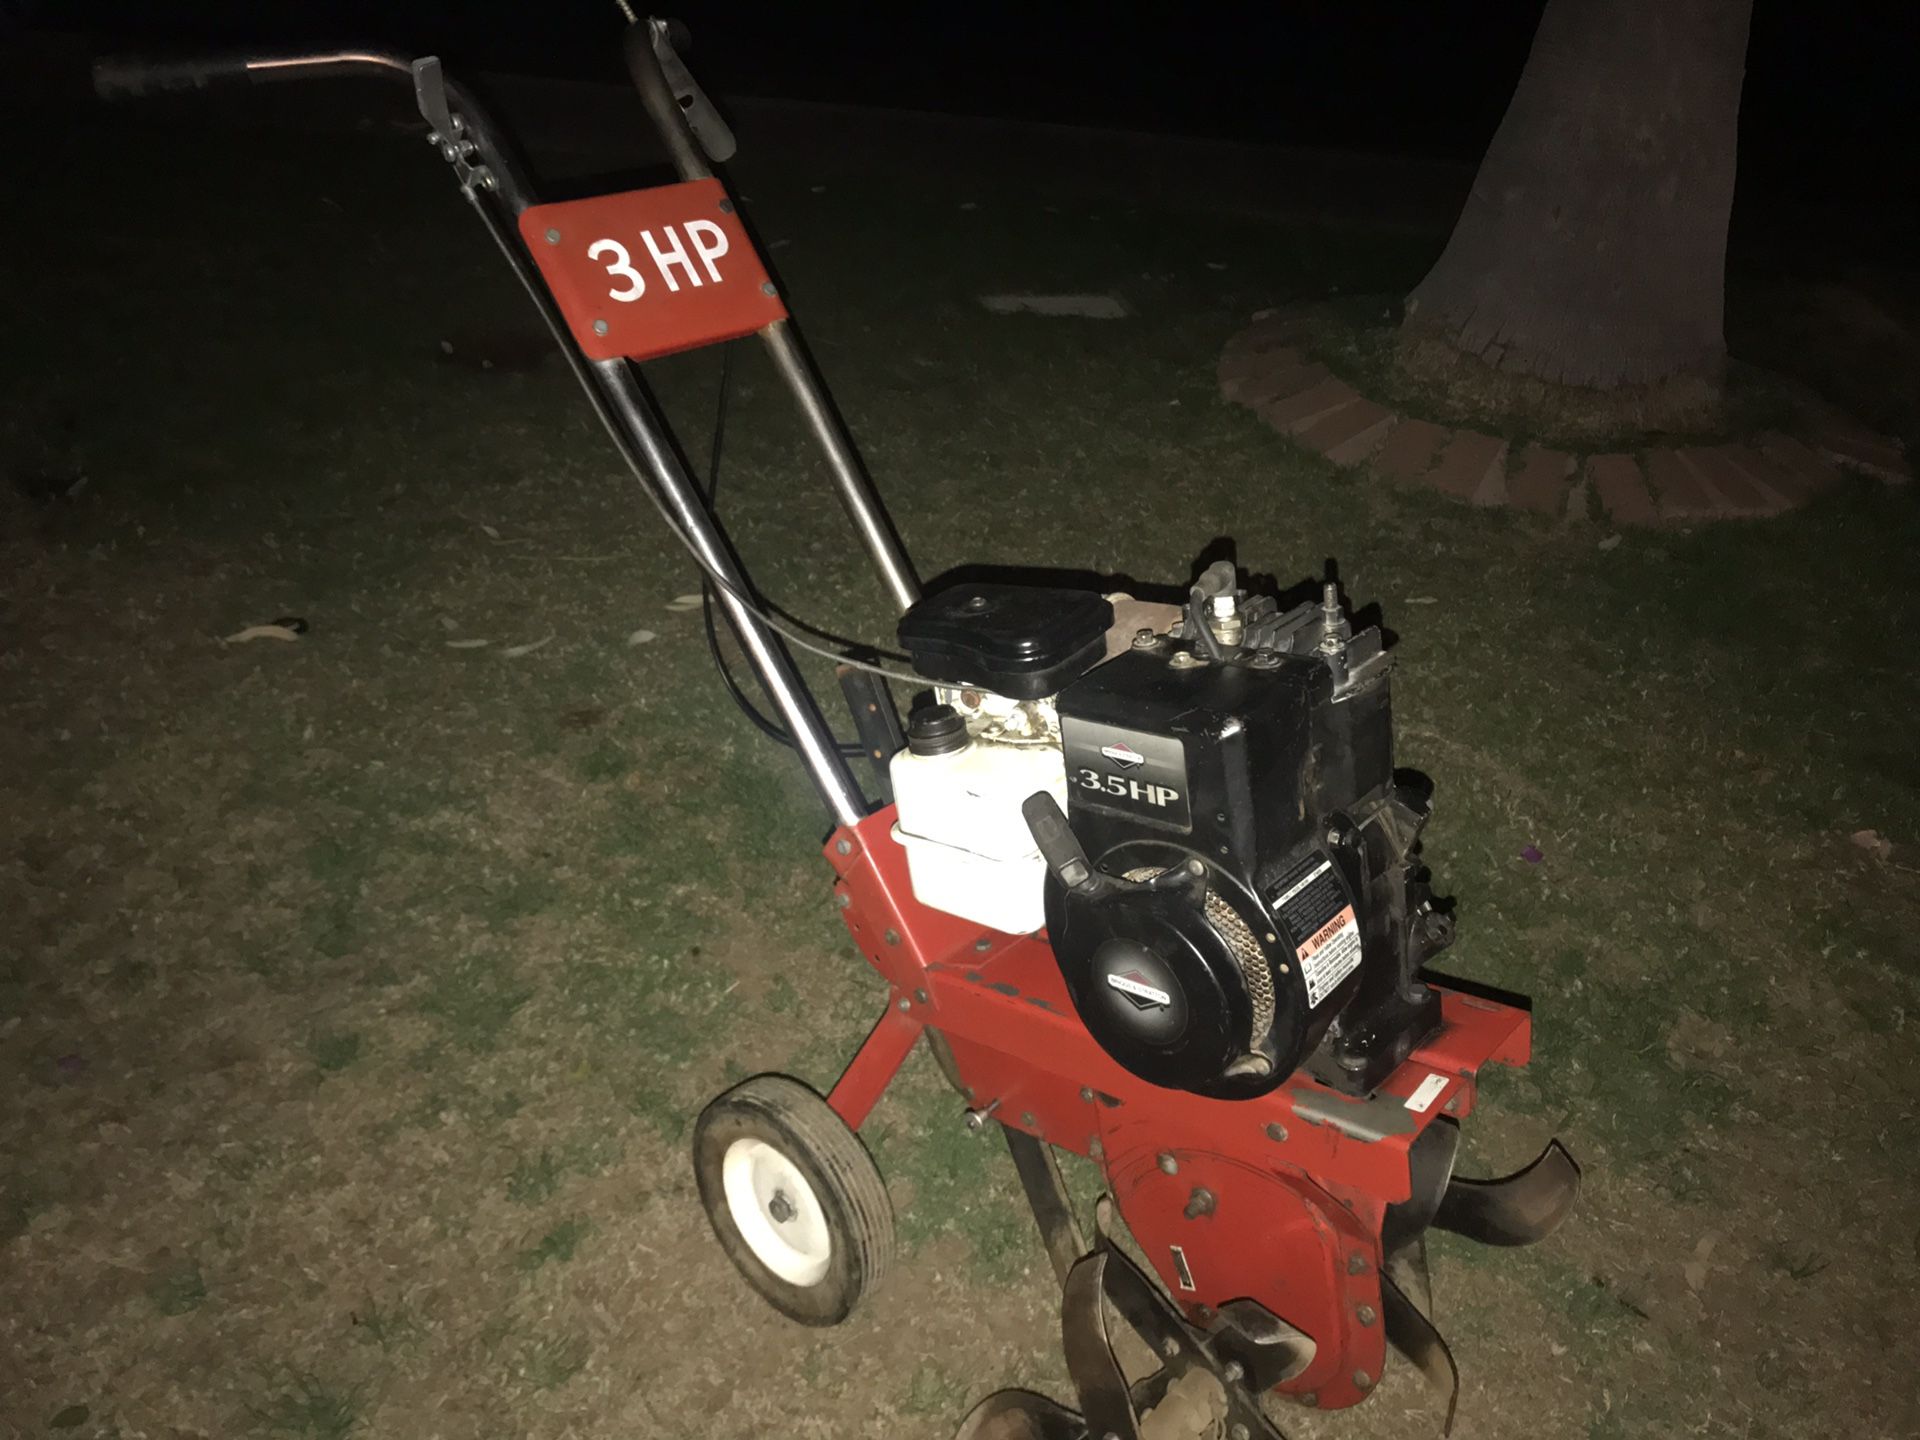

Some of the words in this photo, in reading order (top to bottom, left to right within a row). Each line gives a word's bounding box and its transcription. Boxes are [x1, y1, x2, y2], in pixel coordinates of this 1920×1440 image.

[588, 238, 646, 302] 3
[640, 219, 729, 292] HP
[1311, 915, 1346, 950] WARNING
